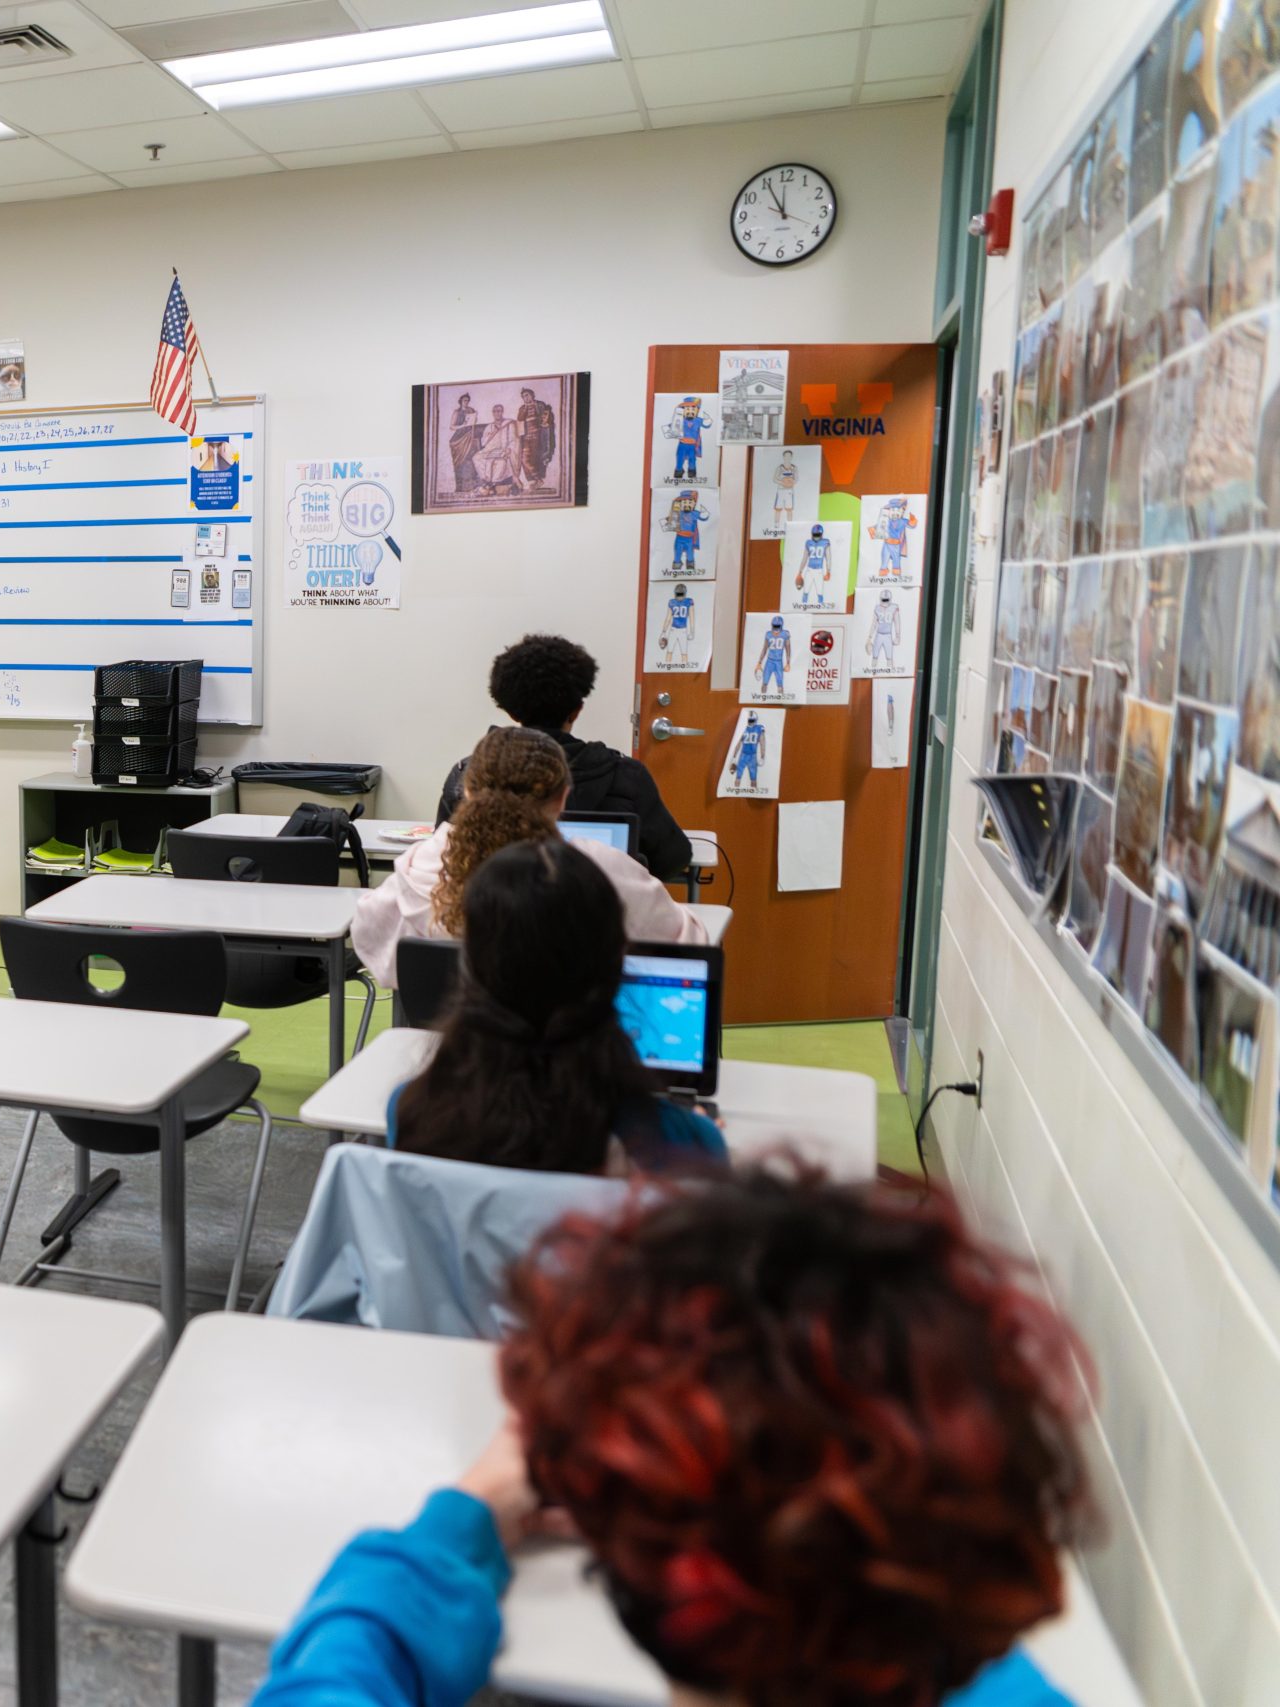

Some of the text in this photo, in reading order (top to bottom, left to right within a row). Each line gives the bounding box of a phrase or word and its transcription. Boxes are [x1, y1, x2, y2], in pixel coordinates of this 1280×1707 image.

[780, 169, 795, 183] 12
[802, 174, 808, 187] 1
[761, 177, 772, 190] 11
[744, 191, 757, 205] 10
[814, 186, 824, 200] 2
[738, 211, 748, 224] 9
[819, 205, 828, 219] 3
[742, 229, 752, 241] 8
[811, 224, 820, 237] 4
[758, 242, 767, 255] 7
[775, 245, 785, 259] 6
[795, 240, 804, 253] 5
[726, 358, 782, 369] VIRGINIA
[802, 417, 886, 437] VIRGINIA
[301, 491, 330, 502] Think
[301, 503, 330, 512] Think
[301, 513, 330, 523] Think
[346, 503, 385, 528] BIG
[307, 544, 359, 568] THINK
[809, 547, 823, 559] 20
[3, 587, 31, 595] Review
[330, 589, 355, 597] ABOUT
[358, 589, 379, 597] WHAT
[320, 598, 361, 606] THINKING
[672, 606, 687, 618] 20
[769, 638, 784, 650] 20
[812, 658, 828, 668] NO
[807, 669, 839, 679] HONE
[743, 732, 758, 744] 20
